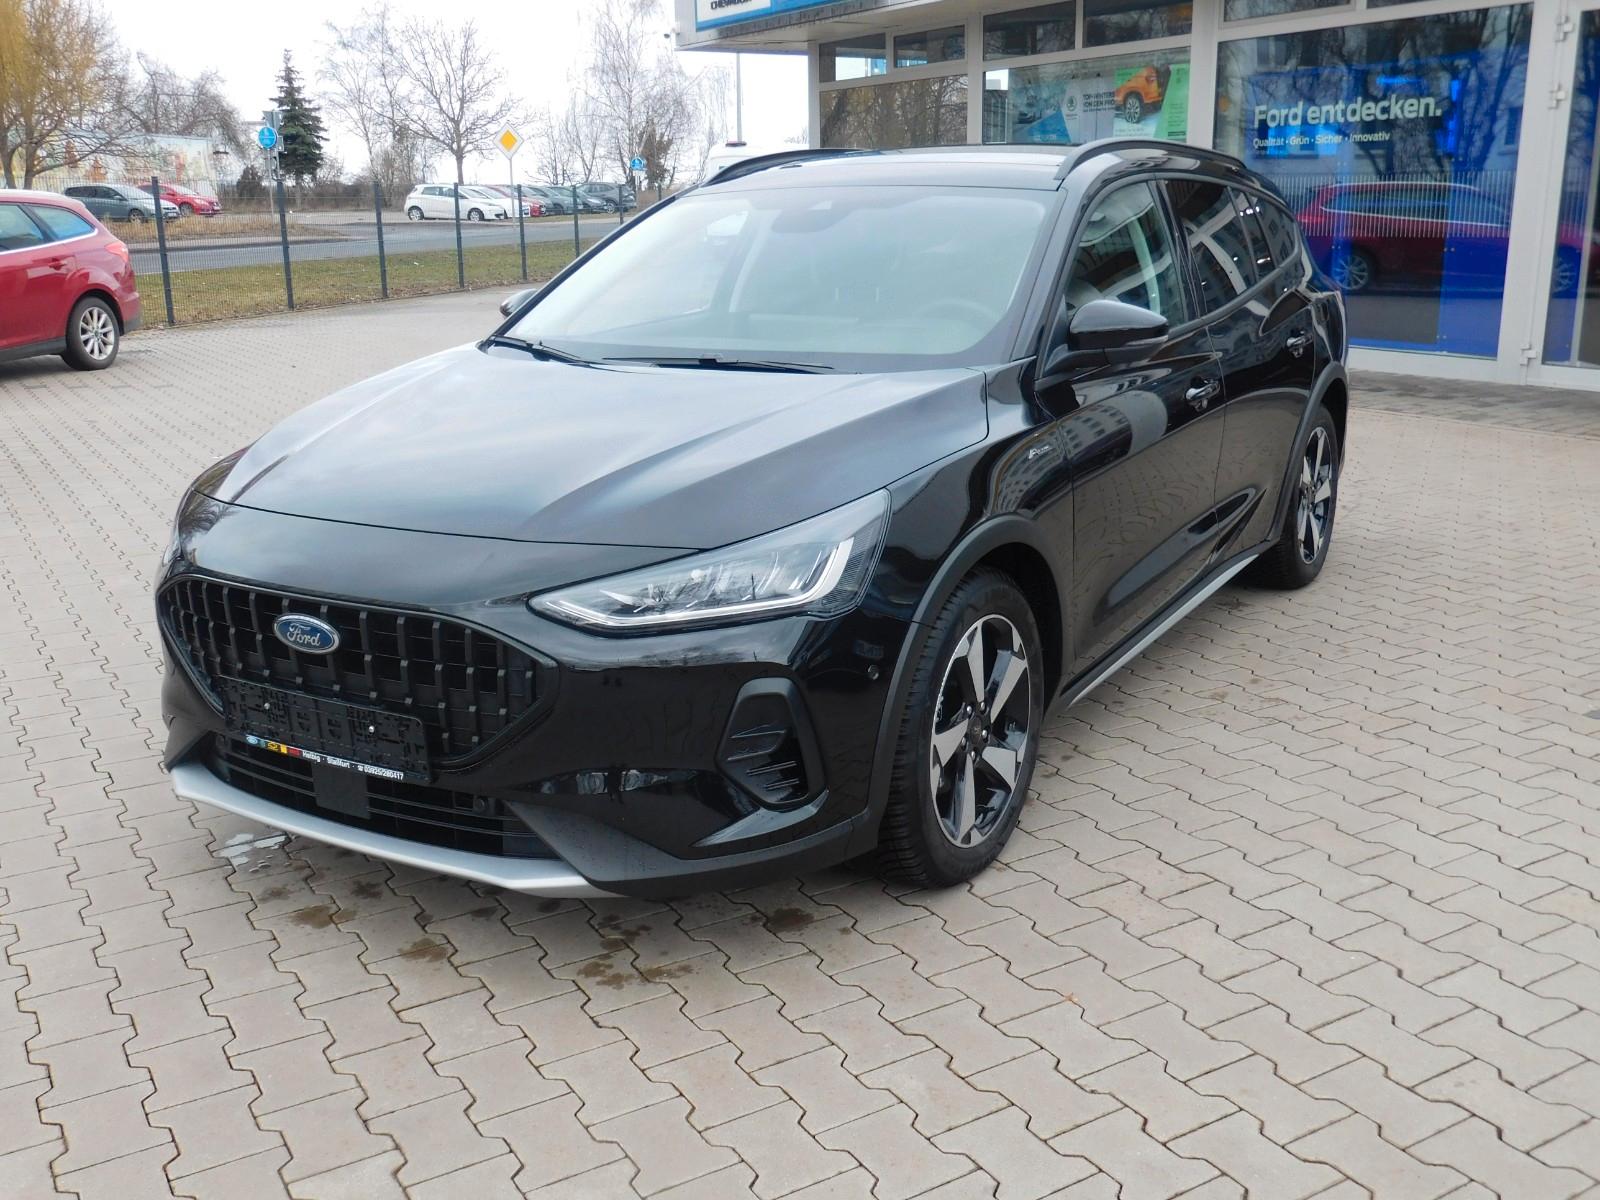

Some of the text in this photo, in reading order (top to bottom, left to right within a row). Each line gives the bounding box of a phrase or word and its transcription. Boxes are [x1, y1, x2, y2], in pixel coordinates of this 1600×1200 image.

[1254, 94, 1442, 129] Ford entdecken.
[1253, 131, 1390, 149] Qualität Grün Sicher Innovativ
[287, 623, 321, 646] Ford
